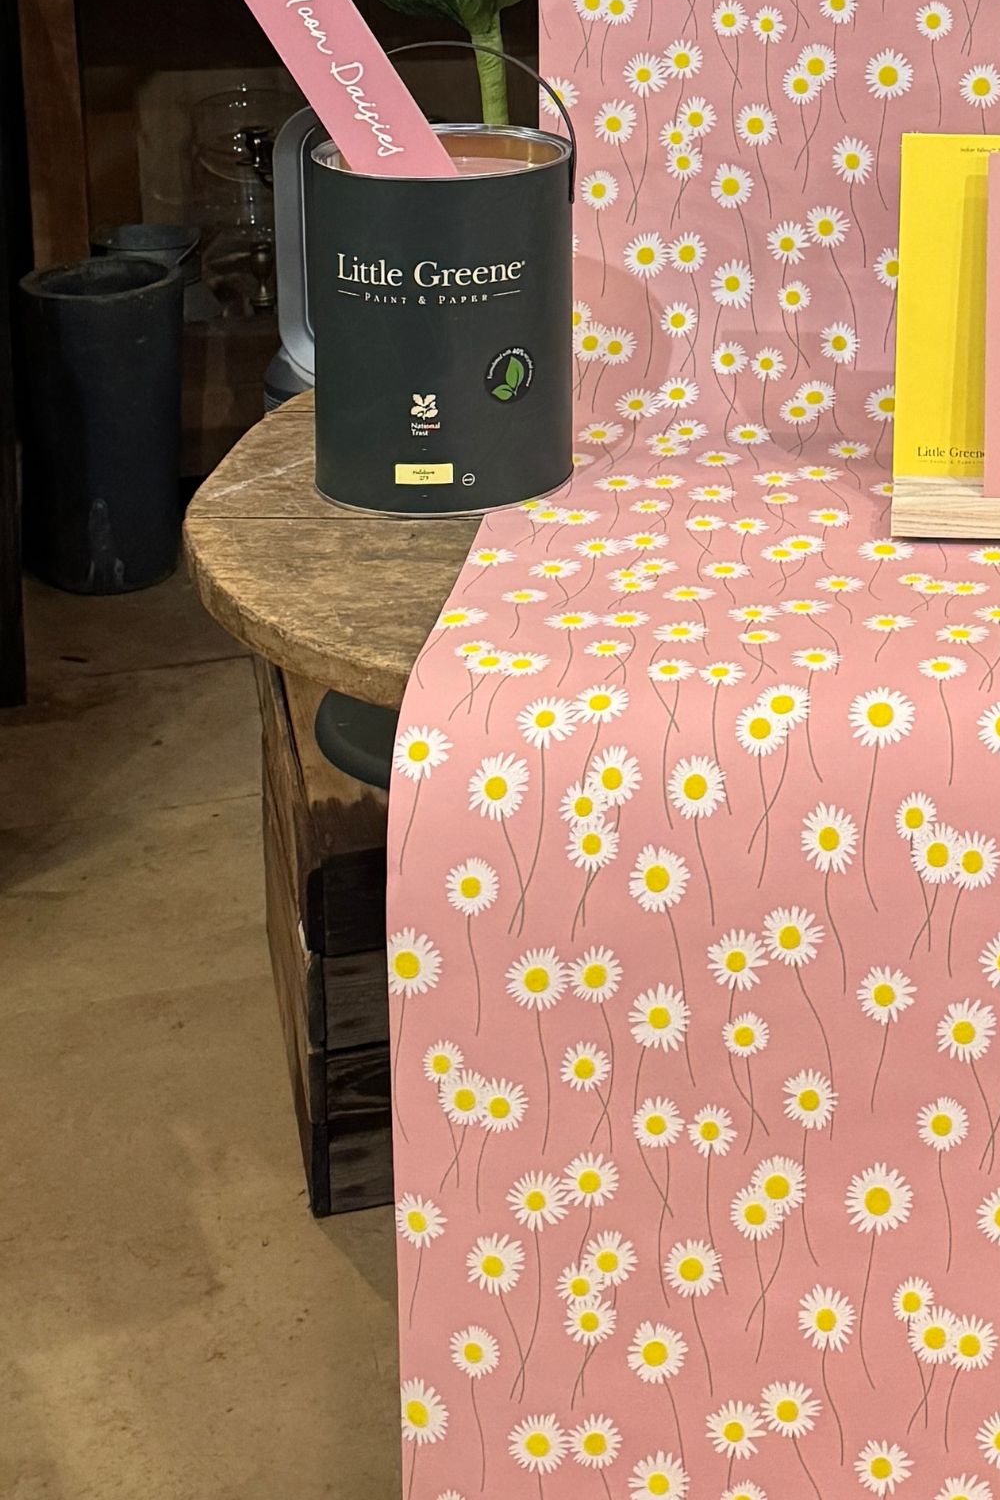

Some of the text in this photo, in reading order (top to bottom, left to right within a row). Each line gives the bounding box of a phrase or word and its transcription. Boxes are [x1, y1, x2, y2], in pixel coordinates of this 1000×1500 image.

[330, 61, 405, 158] Daisies
[336, 252, 522, 288] Little Greene
[917, 446, 946, 457] Little
